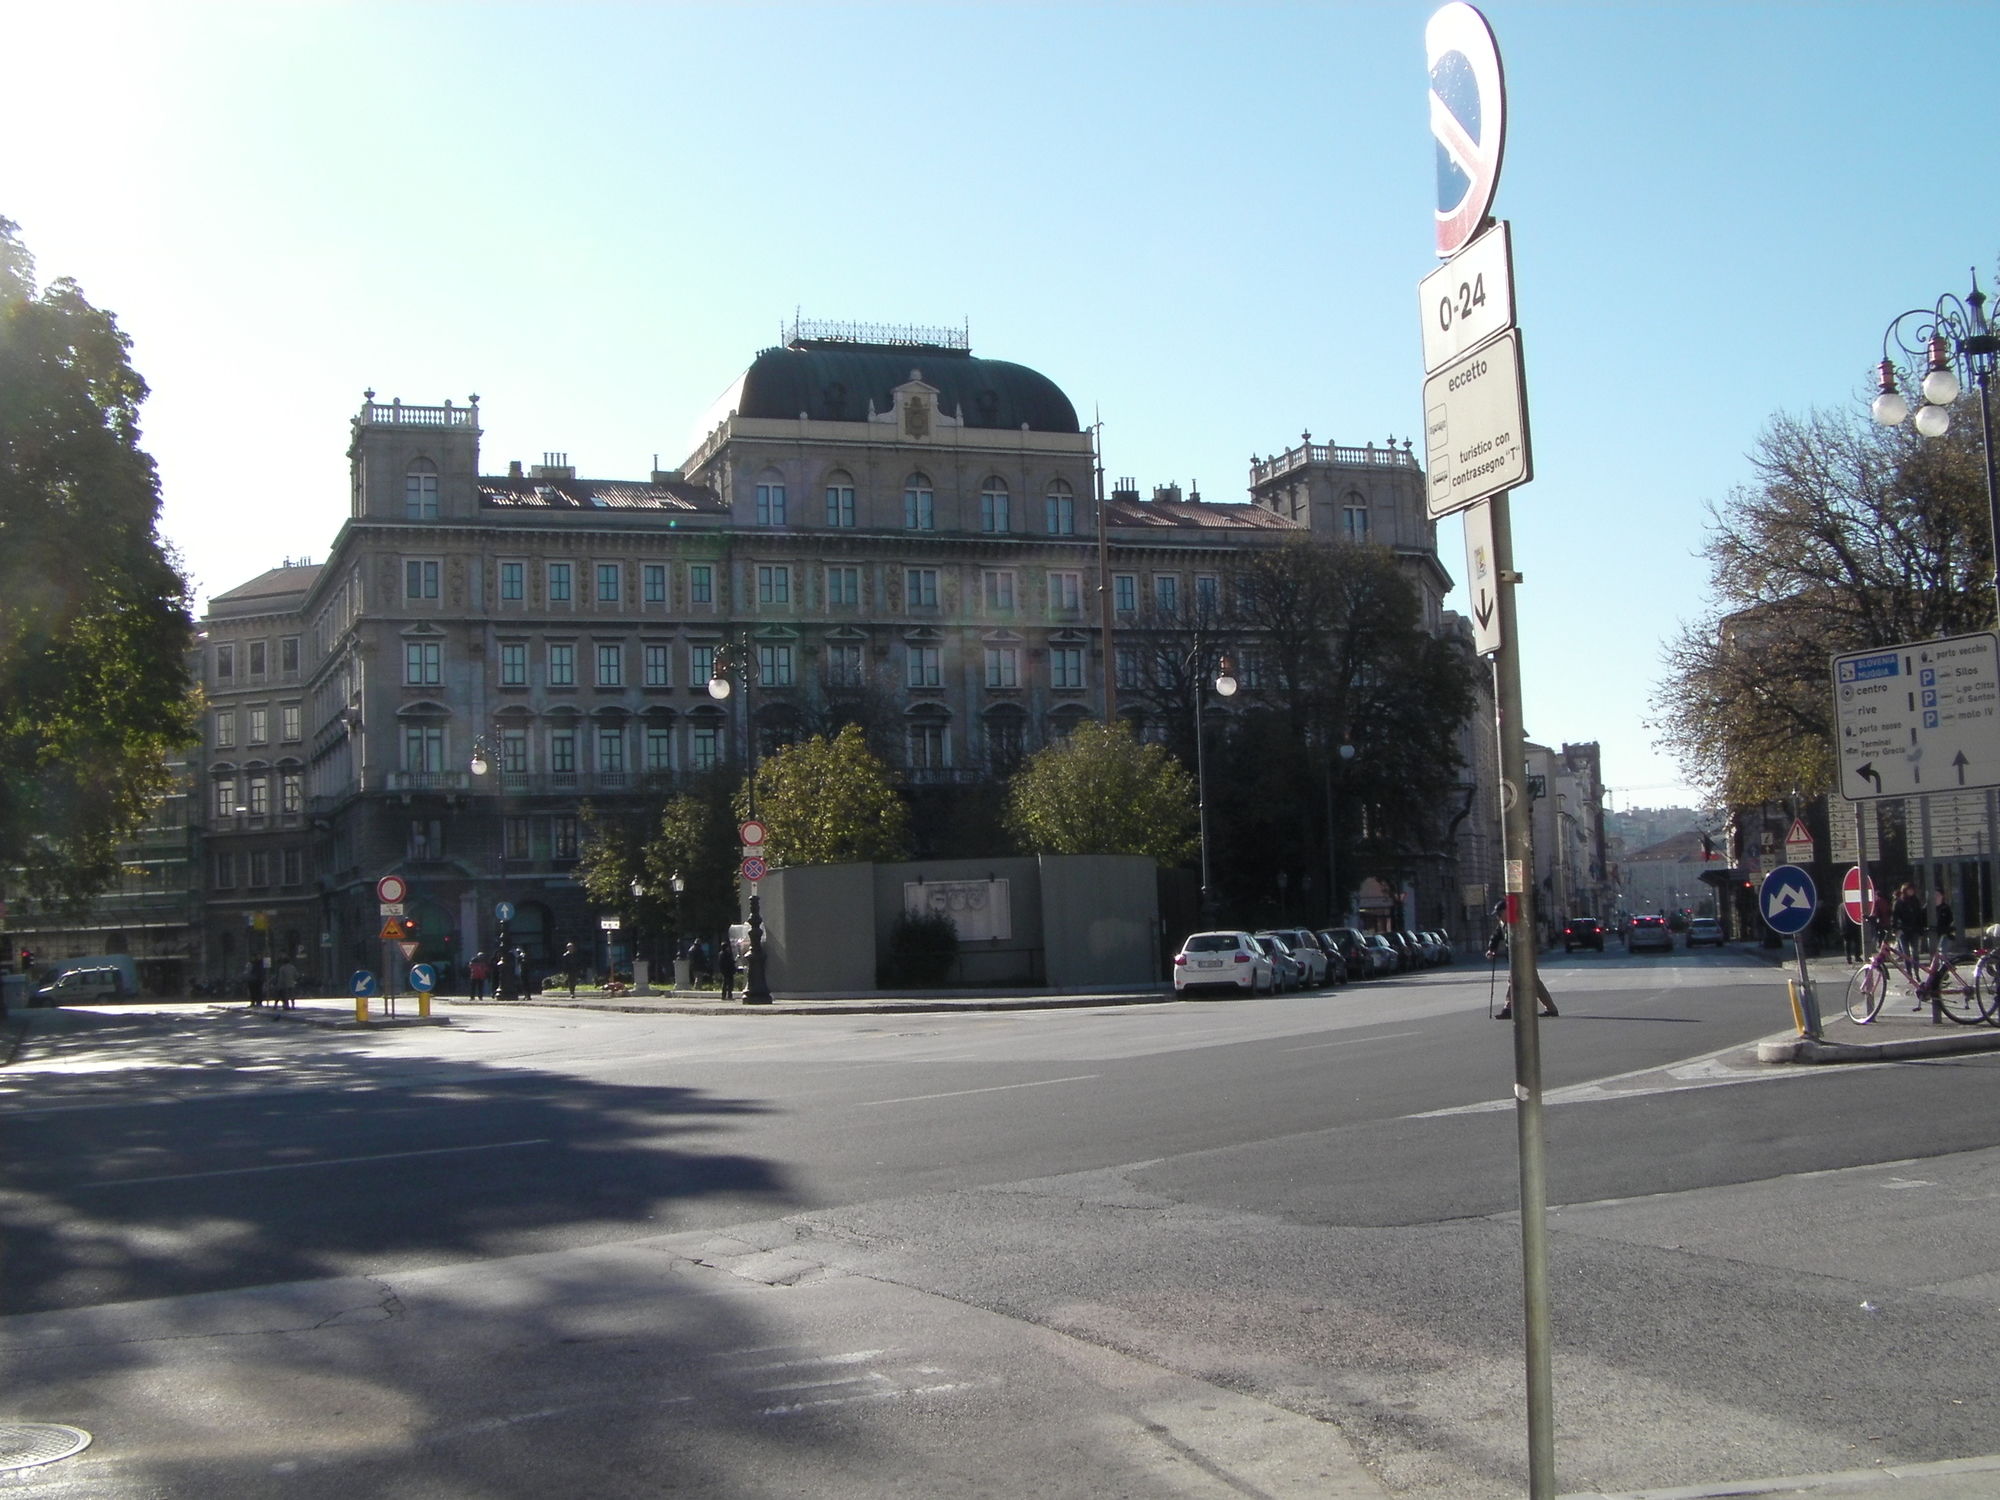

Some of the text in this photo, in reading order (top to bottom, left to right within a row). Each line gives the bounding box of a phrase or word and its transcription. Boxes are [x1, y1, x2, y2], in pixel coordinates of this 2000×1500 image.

[1439, 272, 1486, 331] 0-24
[1448, 360, 1488, 392] eccetto
[1460, 432, 1510, 463] turistico con
[1452, 455, 1505, 487] contrassegno
[1936, 644, 1988, 660] porto vecchio
[1857, 656, 1896, 669] SLOVENIA
[1955, 667, 1978, 677] Silos
[1856, 684, 1888, 696] centro
[1957, 693, 1995, 704] di Santos
[1858, 705, 1877, 715] rive
[1958, 710, 1981, 720] molo
[1985, 707, 1993, 717] IV
[1859, 724, 1878, 735] porto
[1860, 738, 1891, 748] Terminal
[1861, 747, 1906, 759] Ferry Grecia
